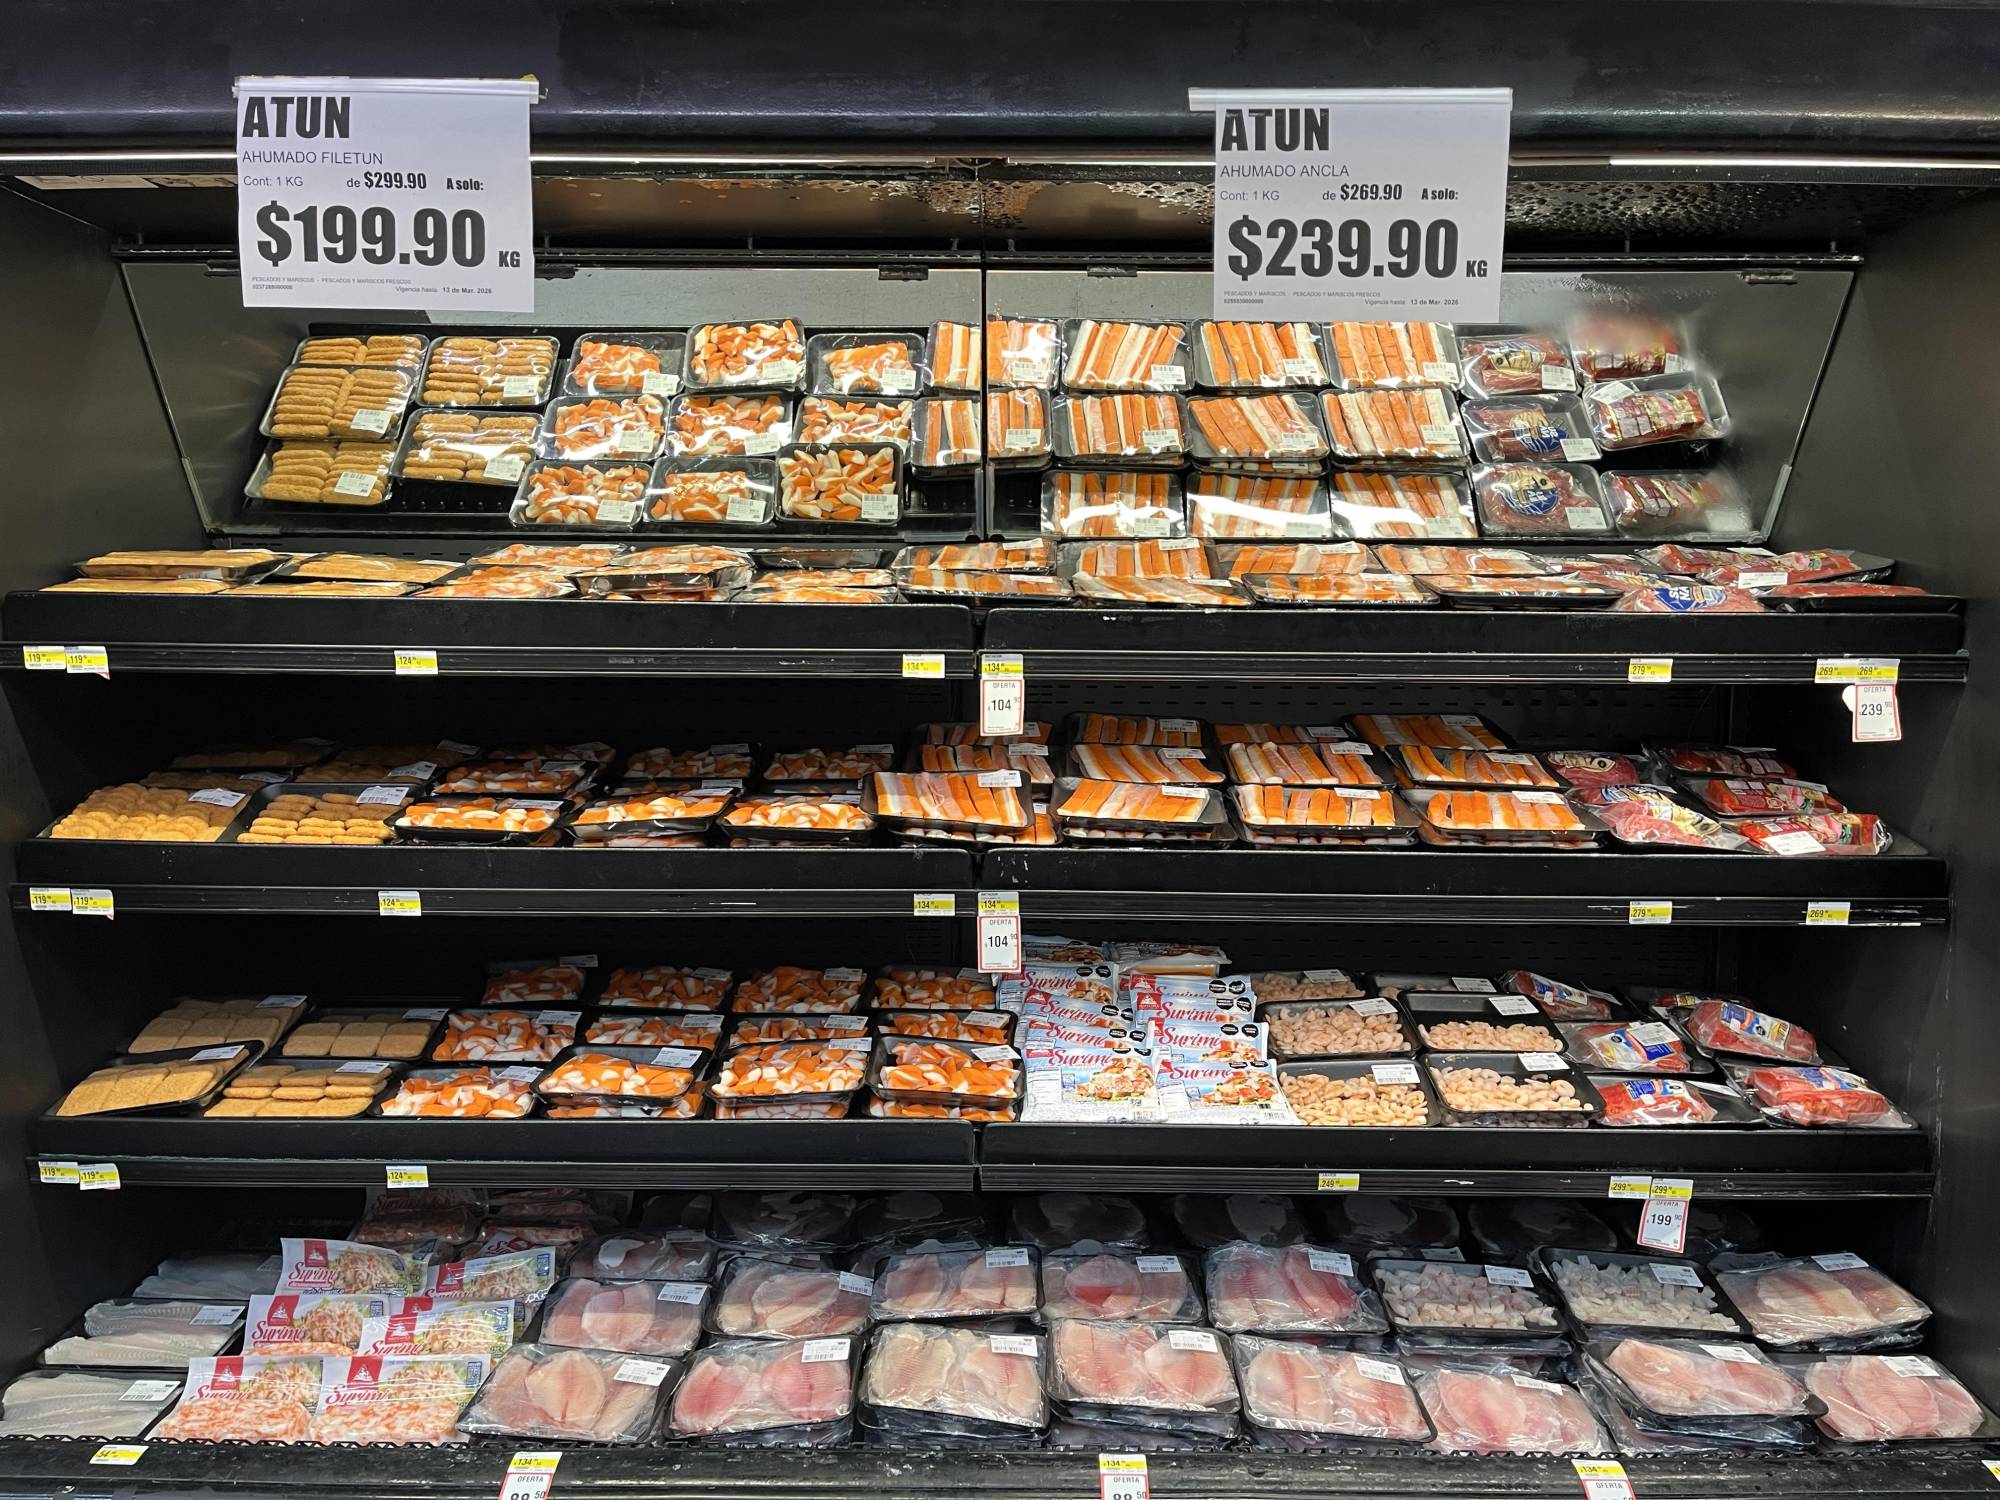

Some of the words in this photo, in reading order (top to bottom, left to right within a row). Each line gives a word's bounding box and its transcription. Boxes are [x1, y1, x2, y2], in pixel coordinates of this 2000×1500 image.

[242, 97, 350, 138] ATUN
[1220, 108, 1330, 152] ATUN
[242, 151, 316, 164] AHUMADO
[321, 152, 384, 165] FILETUN
[1220, 165, 1296, 177] AHUMADO
[1300, 165, 1350, 177] ANCLA
[244, 176, 272, 187] Cont:
[276, 176, 282, 186] 1
[286, 177, 304, 187] KG
[346, 177, 360, 188] de
[364, 172, 426, 190] $299.90
[446, 178, 454, 190] A
[455, 178, 484, 191] solo:
[1220, 190, 1249, 200] Cont:
[1252, 190, 1258, 200] 1
[1262, 190, 1280, 200] KG
[1322, 190, 1336, 200] de
[1340, 184, 1402, 200] $269.90
[1421, 188, 1430, 200] A
[1431, 188, 1458, 201] solo:
[256, 200, 486, 268] $199.90
[1228, 215, 1458, 281] $239.90
[498, 251, 521, 268] KG
[1466, 260, 1488, 278] KG
[1021, 972, 1078, 989] Surimi
[1040, 1001, 1098, 1023] Surimi
[1158, 1002, 1216, 1022] Surimi
[1046, 1022, 1105, 1047] Surimi
[1159, 1027, 1222, 1047] Surimi
[1049, 1049, 1112, 1066] Surimi
[1170, 1066, 1232, 1080] Surimi
